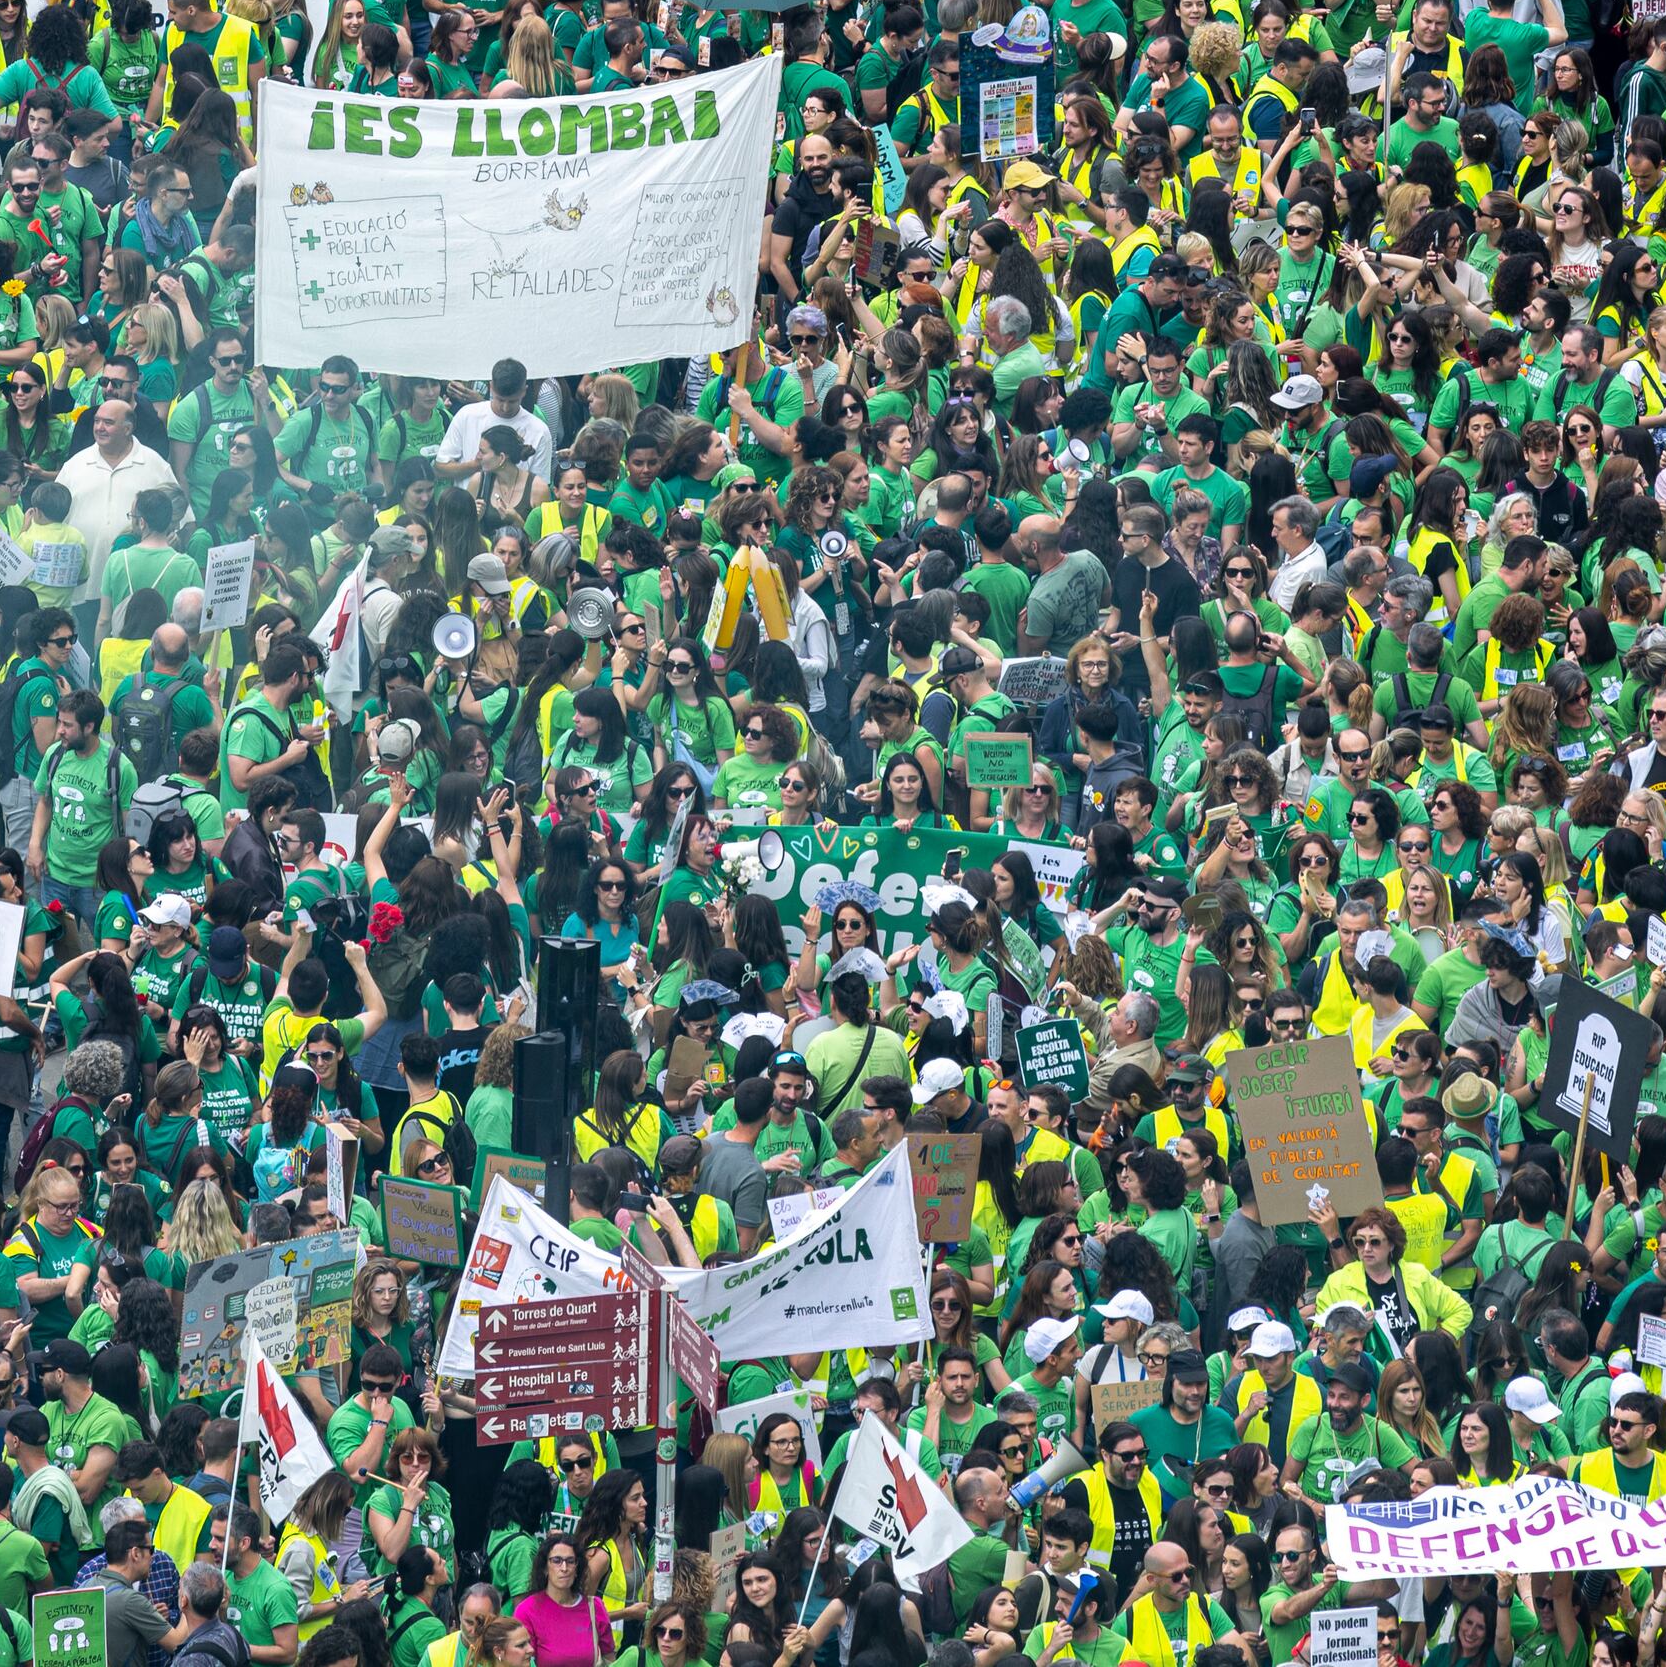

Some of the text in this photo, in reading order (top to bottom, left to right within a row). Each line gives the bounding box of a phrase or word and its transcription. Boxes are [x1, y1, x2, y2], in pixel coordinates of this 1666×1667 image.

[307, 90, 720, 158] IES LLOMBAI
[474, 159, 590, 182] BORRIANA
[323, 213, 407, 236] EDUCACIÓ
[327, 234, 396, 255] PÚBLICA
[327, 263, 404, 287] IGUALTAT
[324, 287, 432, 314] D'OPORTUNITATS
[1256, 1044, 1310, 1072] CEIP
[1238, 1071, 1297, 1100] JOSEP
[1286, 1088, 1353, 1119] ITURBI
[513, 1302, 597, 1321] Torres de Quart
[508, 1341, 605, 1358] Pavelló Font de Sant Lluís
[509, 1369, 588, 1389] Hospital La Fe
[1318, 1616, 1368, 1634] NO podem
[1327, 1636, 1361, 1649] formar
[1311, 1647, 1377, 1666] professionals
